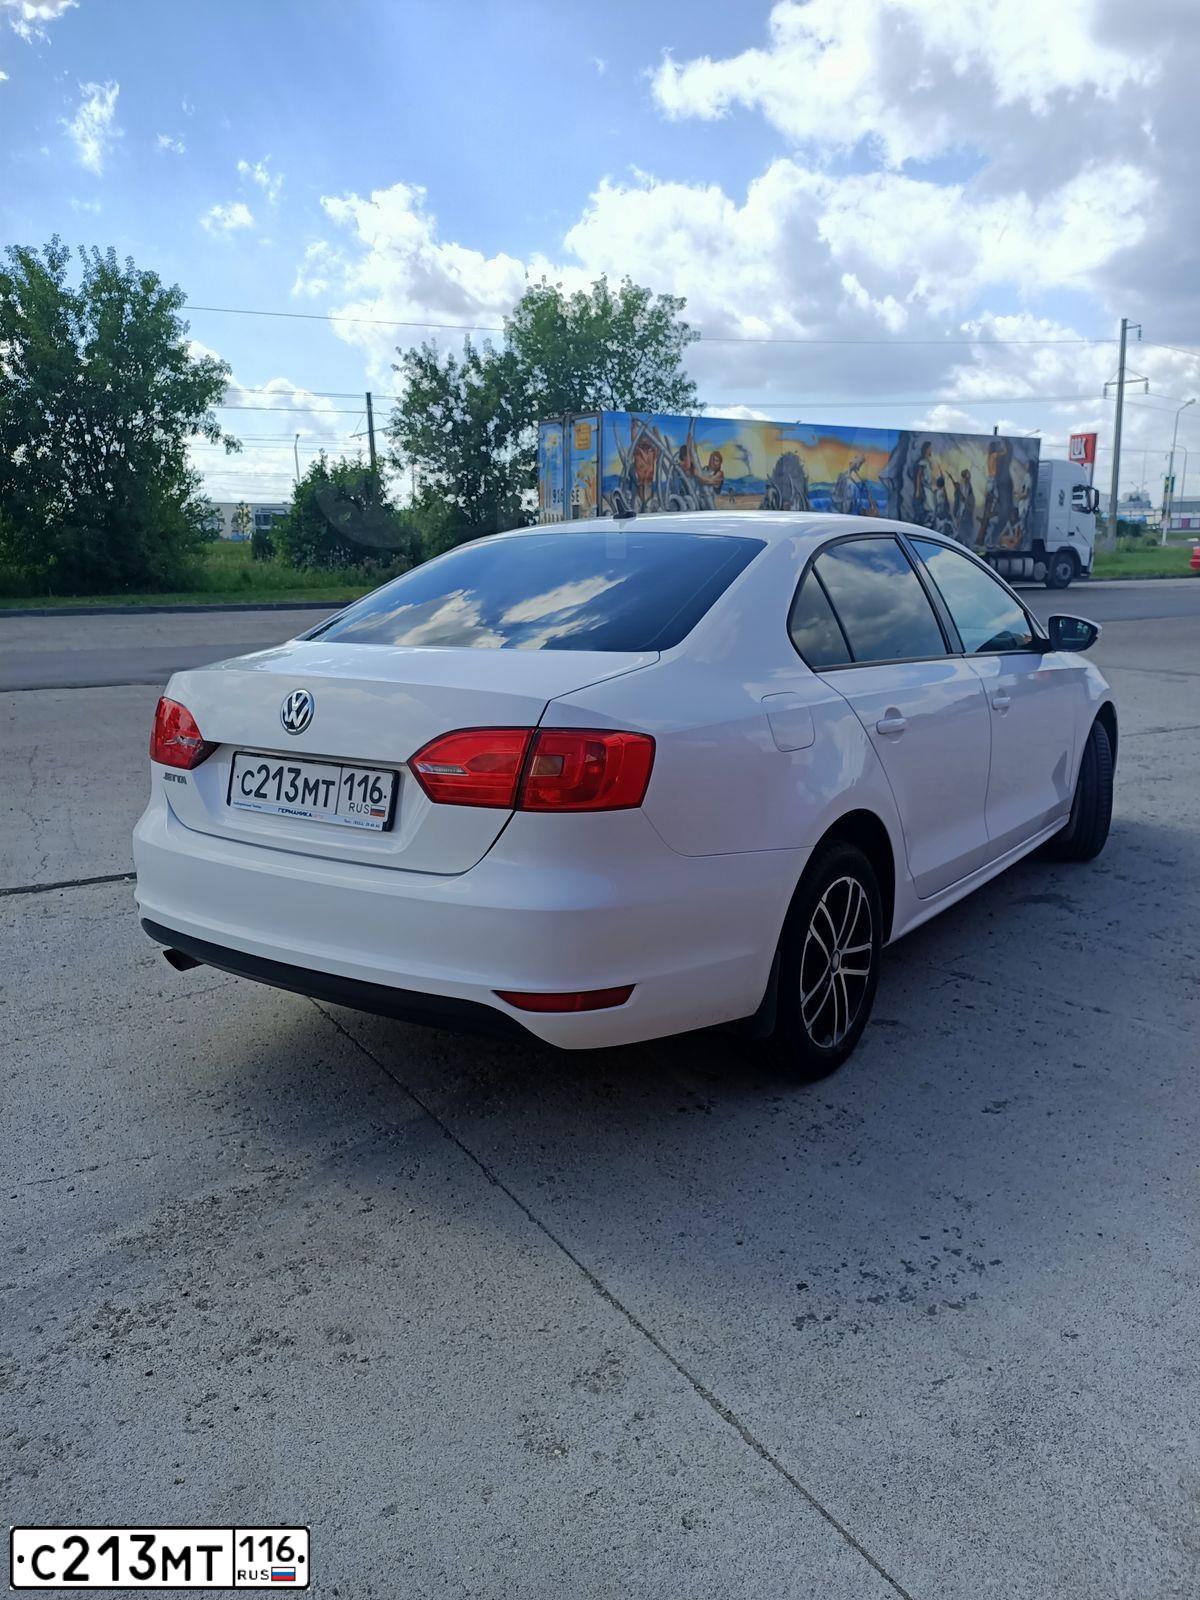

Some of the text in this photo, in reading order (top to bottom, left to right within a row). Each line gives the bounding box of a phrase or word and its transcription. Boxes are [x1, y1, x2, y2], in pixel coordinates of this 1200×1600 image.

[241, 764, 383, 808] С213МТ 116
[277, 807, 313, 818] ГЕРМАНИКА
[348, 802, 370, 815] RUS
